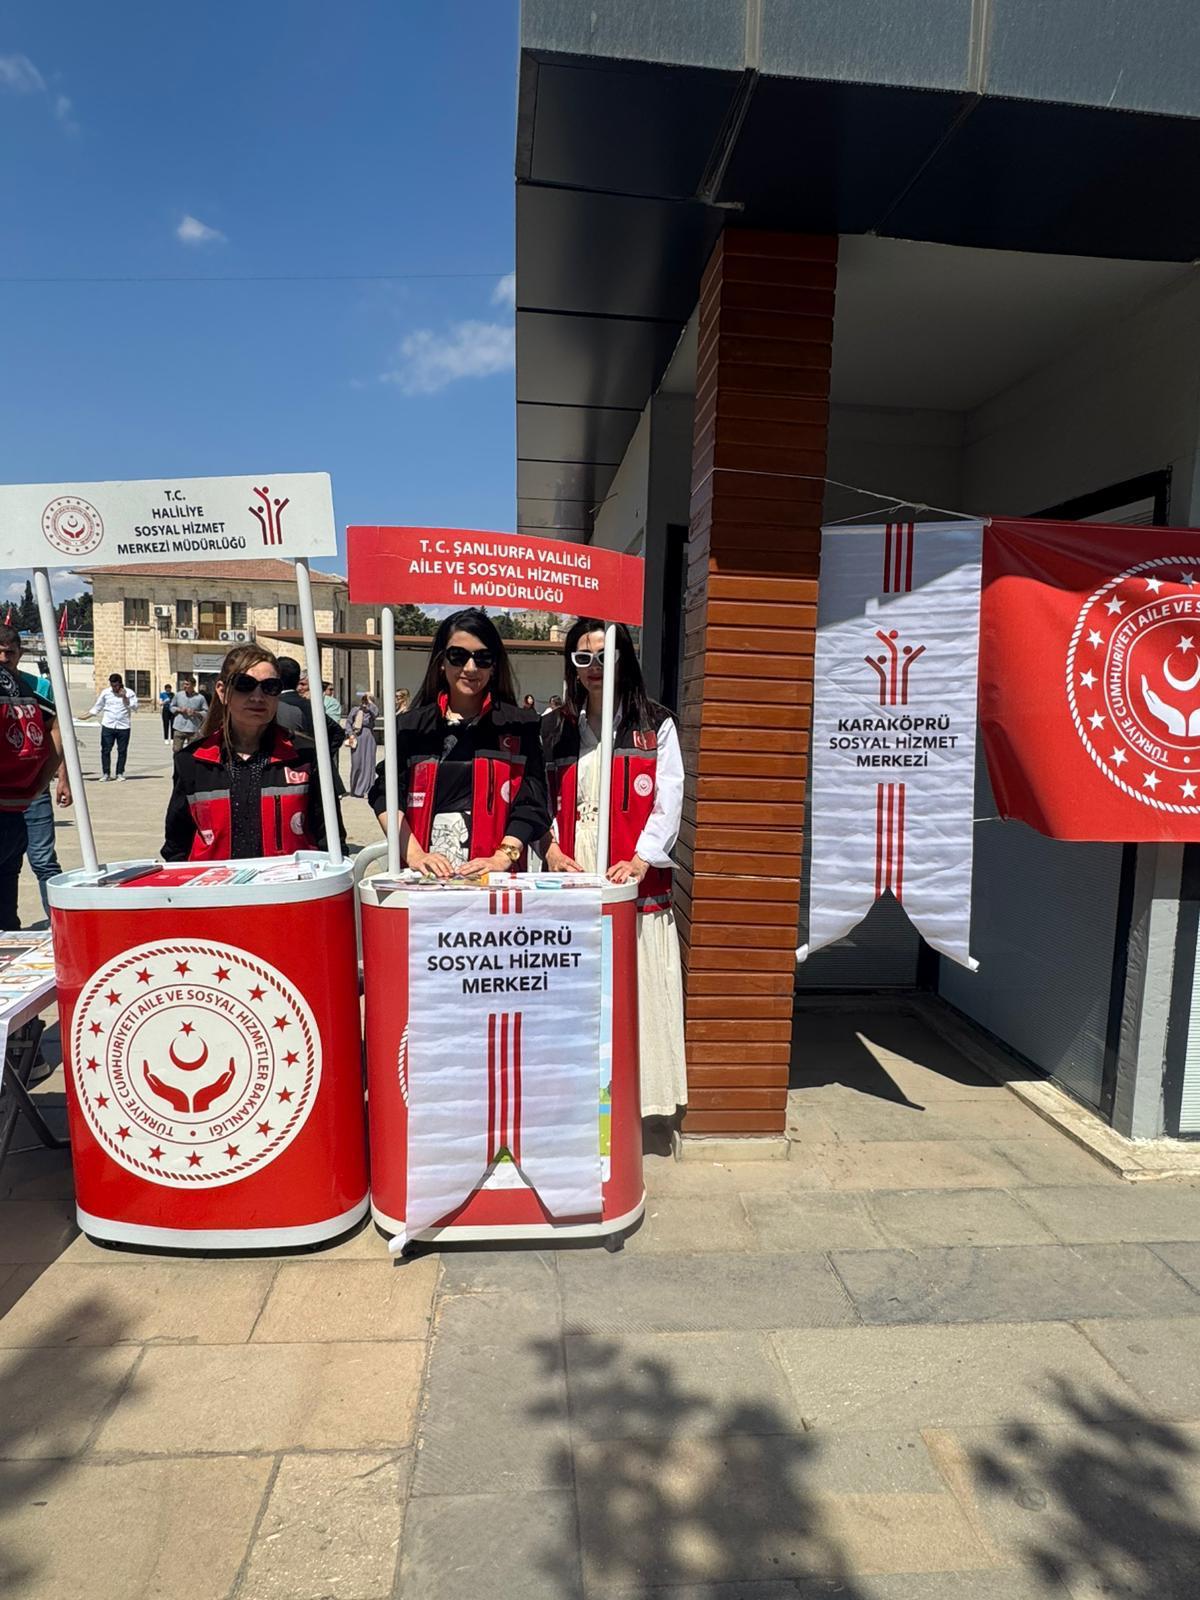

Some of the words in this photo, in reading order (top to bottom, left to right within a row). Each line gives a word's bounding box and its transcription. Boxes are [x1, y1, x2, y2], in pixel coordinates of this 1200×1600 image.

[164, 489, 186, 501] T.C.
[152, 506, 204, 519] HALİLİYE
[135, 524, 180, 537] SOSYAL
[182, 522, 226, 535] HİZMET
[117, 539, 170, 555] MERKEZİ
[172, 536, 247, 552] MÜDÜRLÜĞÜ
[453, 540, 535, 560] ŞANLIURFA
[538, 550, 592, 570] VALİLİĞİ
[408, 558, 442, 574] AİLE
[445, 561, 465, 575] VE
[468, 563, 525, 580] SOSYAL
[527, 567, 600, 591] HİZMETLER
[453, 579, 467, 595] İL
[470, 580, 564, 604] MÜDÜRLÜĞÜ
[1138, 603, 1171, 628] AİLE
[1173, 600, 1192, 613] VE
[1110, 620, 1137, 717] CUMHURİYETİ
[838, 714, 950, 732] KARAKÖPRÜ
[829, 737, 890, 750] SOSYAL
[895, 733, 958, 749] HİZMET
[1121, 717, 1168, 762] TÜRKİYE
[857, 751, 928, 767] MERKEZİ
[438, 926, 572, 948] KARAKÖPRÜ
[427, 954, 503, 971] SOSYAL
[509, 949, 582, 969] HİZMET
[462, 971, 548, 994] MERKEZİ
[137, 994, 165, 1016] AİLE
[165, 989, 184, 1002] VE
[187, 989, 236, 1015] SOSYAL
[111, 1009, 139, 1098] CUMHURİYETİ
[236, 1010, 269, 1080] HİZMETLER
[125, 1098, 174, 1137] TÜRKİYE
[209, 1083, 266, 1137] BAKANLIĞI
